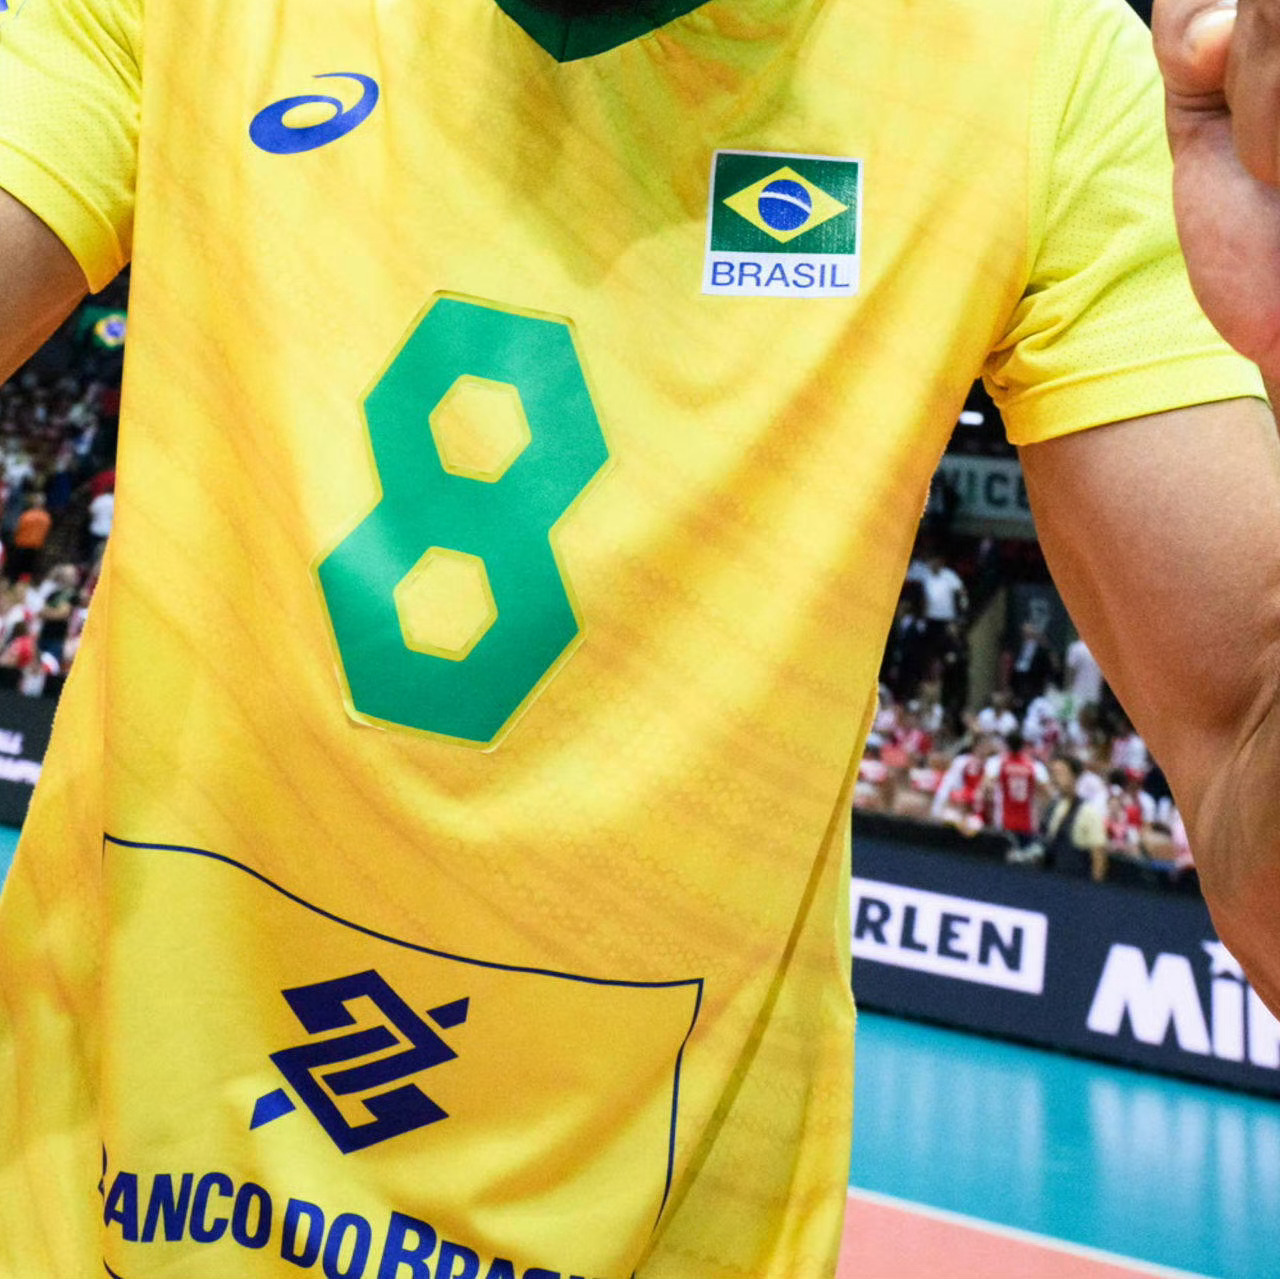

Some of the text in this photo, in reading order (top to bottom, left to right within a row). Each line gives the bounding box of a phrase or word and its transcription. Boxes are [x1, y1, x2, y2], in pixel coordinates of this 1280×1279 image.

[710, 261, 850, 288] BRASIL
[312, 292, 613, 751] 8
[854, 896, 1023, 973] RLEN
[100, 1171, 273, 1249] ANCO
[280, 1198, 373, 1279] DO
